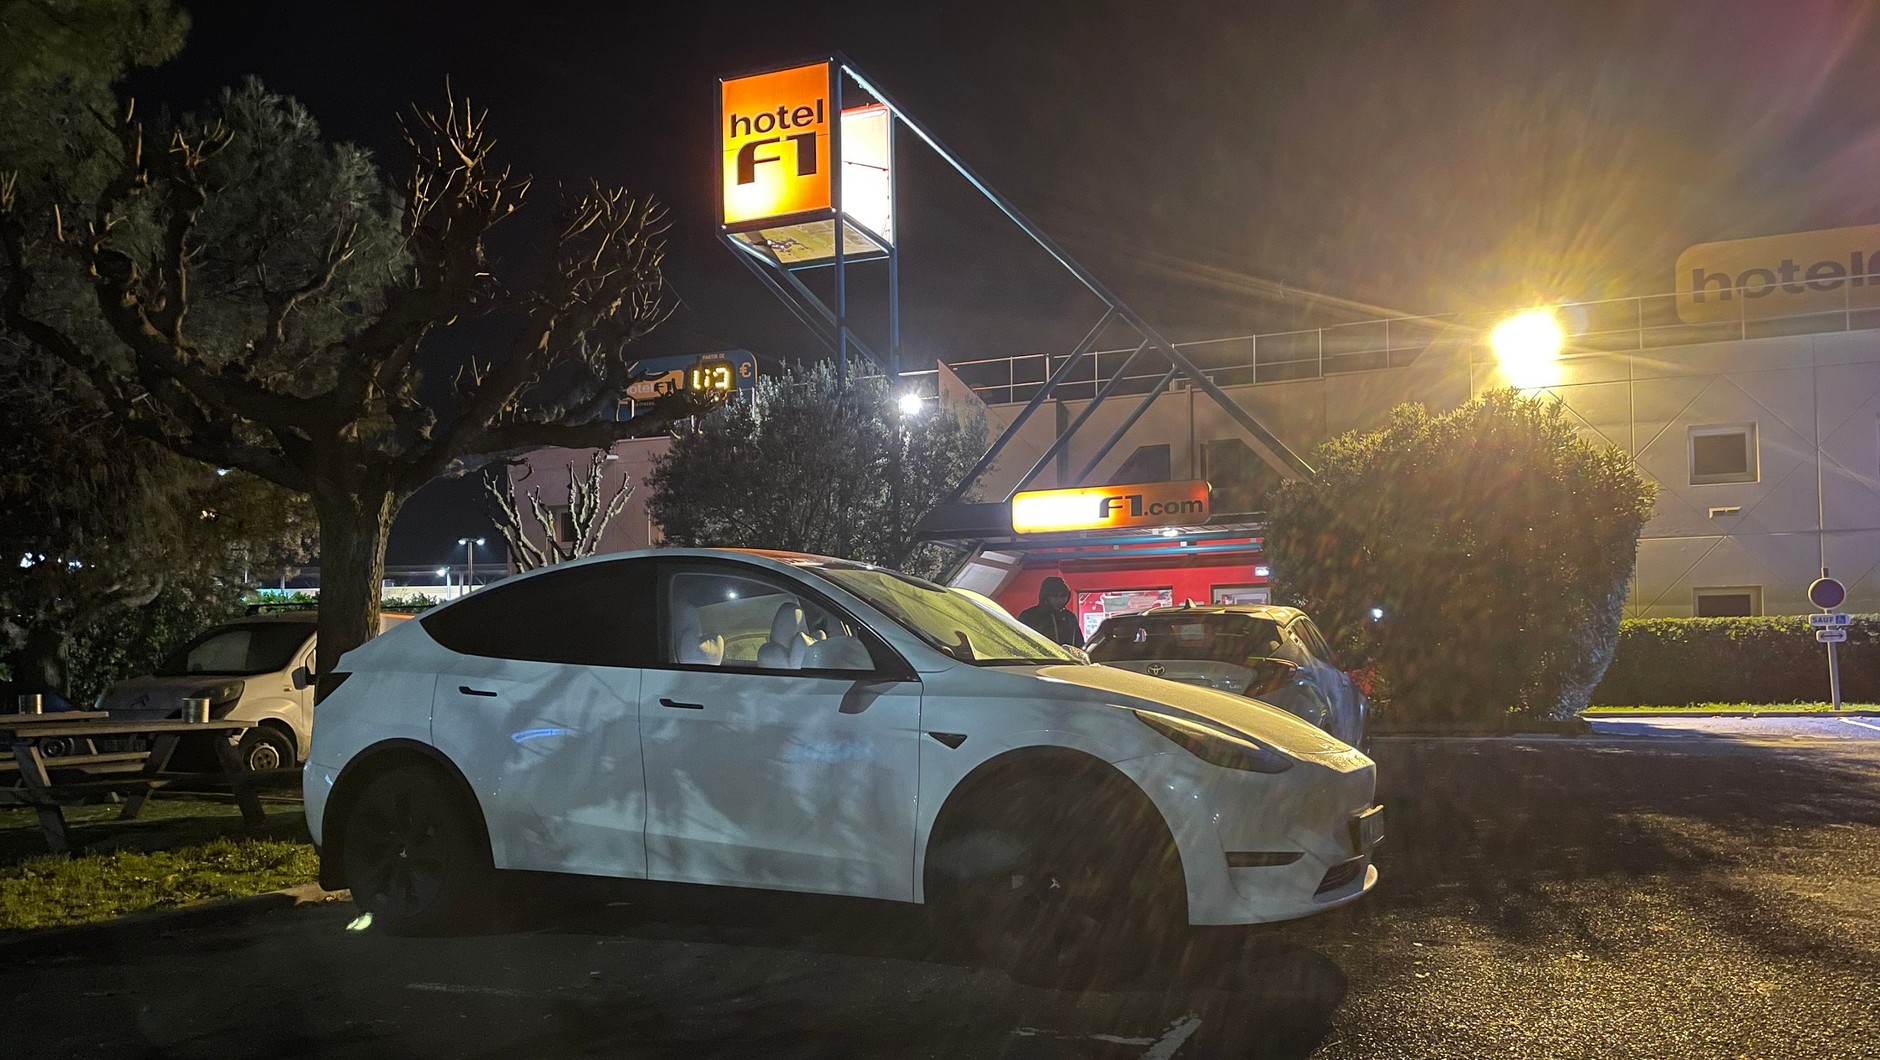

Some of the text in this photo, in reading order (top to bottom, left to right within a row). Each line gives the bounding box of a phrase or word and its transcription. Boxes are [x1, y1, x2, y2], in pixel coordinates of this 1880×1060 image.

[731, 98, 823, 138] hotel
[737, 131, 816, 185] F1
[1692, 251, 1864, 304] hotel
[629, 382, 655, 395] otel
[1099, 494, 1204, 518] F1.com
[1812, 616, 1834, 624] SAUF
